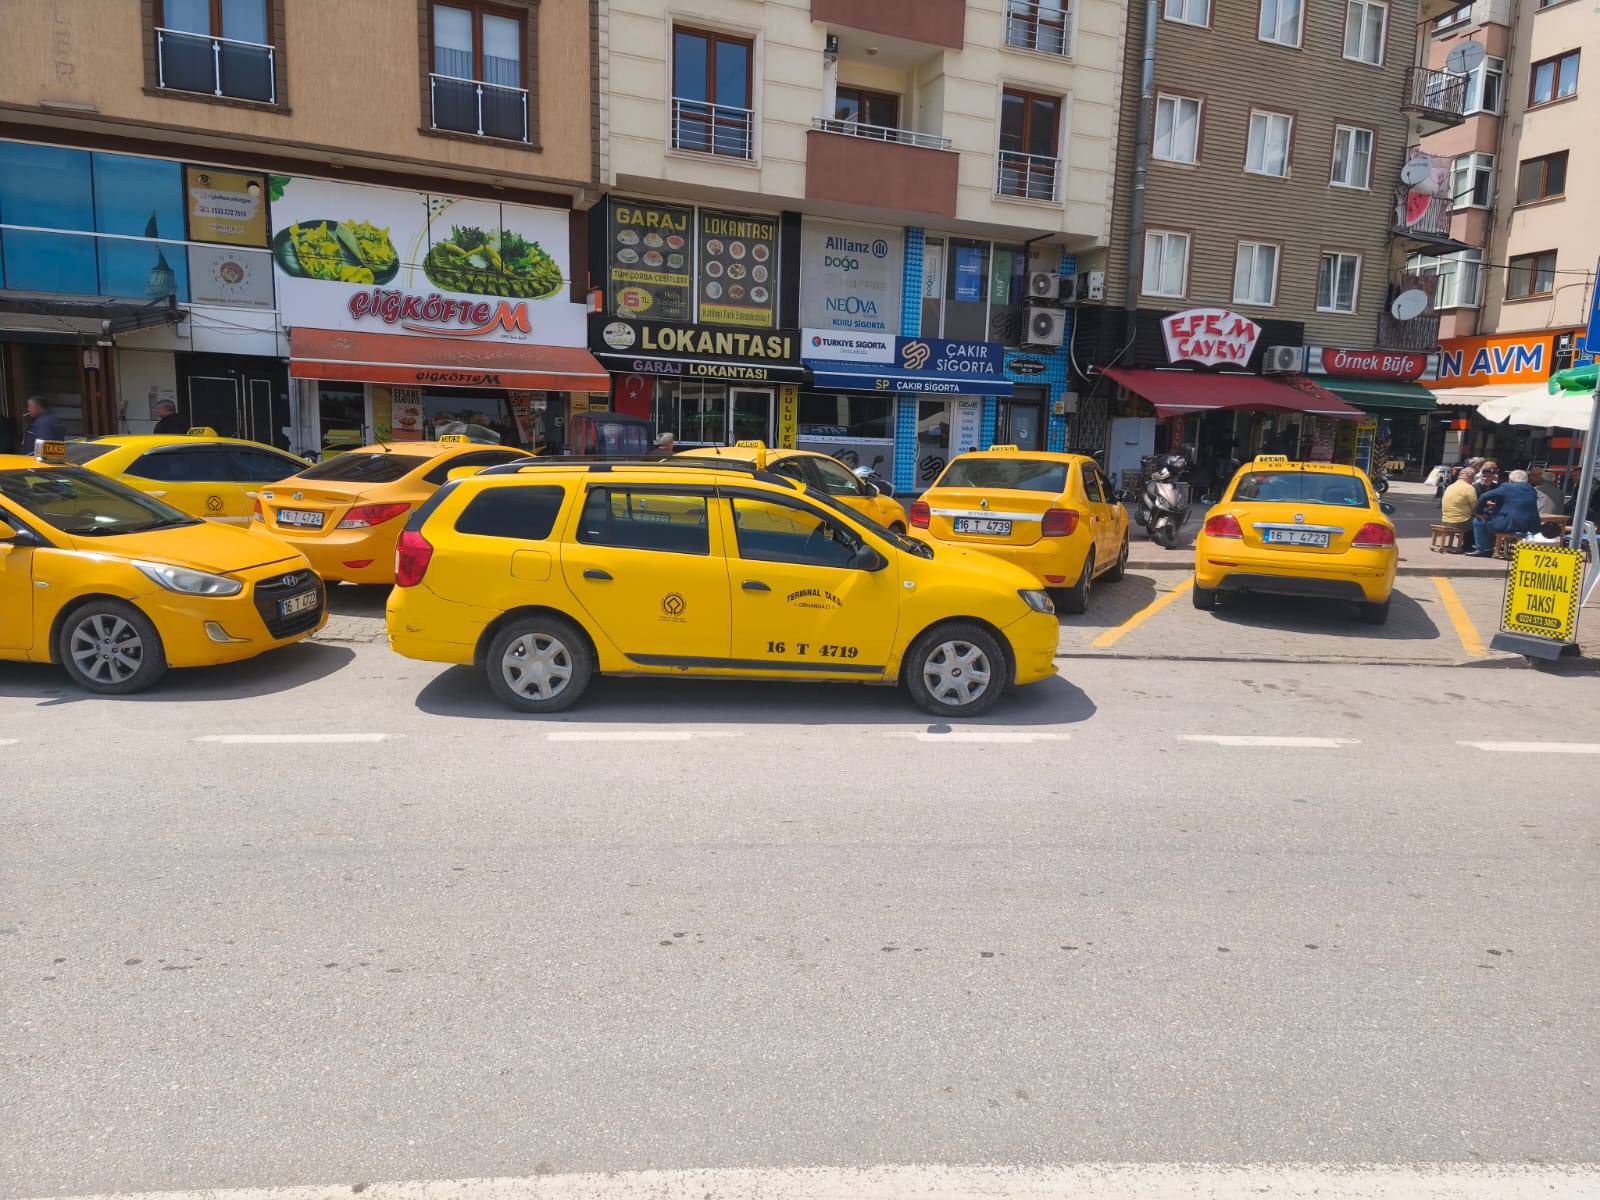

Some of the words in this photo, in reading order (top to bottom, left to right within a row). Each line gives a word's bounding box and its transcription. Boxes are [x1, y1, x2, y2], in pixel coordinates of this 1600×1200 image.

[616, 207, 687, 231] GARAJ
[704, 217, 773, 241] LOKANTASI
[825, 236, 870, 254] Allianz
[824, 255, 859, 272] Doğa
[630, 272, 653, 282] ÇORBA
[641, 296, 650, 304] TL
[826, 296, 878, 315] NEOVA
[832, 318, 852, 327] KORU
[1170, 311, 1255, 342] EFE'M
[642, 326, 791, 359] LOKANTASI
[946, 343, 988, 359] ÇAKIR
[936, 358, 994, 374] SİGORTA
[1334, 350, 1379, 371] Örnek
[1383, 353, 1415, 375] Büfe
[1468, 341, 1545, 376] AVM
[633, 360, 682, 374] GARAJ
[689, 363, 768, 380] LOKANTASI
[875, 379, 890, 391] SP
[897, 381, 922, 392] ÇAKIR
[924, 381, 960, 393] SİGORTA
[282, 510, 291, 521] 16
[293, 511, 299, 522] T
[301, 512, 321, 525] 4724
[960, 519, 969, 530] 16
[974, 520, 980, 531] T
[986, 521, 1010, 532] 4739
[1271, 530, 1282, 541] 16
[1289, 531, 1295, 542] T
[1300, 532, 1328, 545] 4723
[1534, 554, 1559, 569] 7/24
[1518, 570, 1569, 594] TERMİNAL
[285, 601, 293, 613] 16
[295, 598, 300, 610] T
[302, 591, 317, 607] 4722
[1526, 593, 1556, 615] TAKSİ
[767, 641, 786, 654] 16
[796, 643, 810, 656] T
[818, 644, 859, 659] 4719
